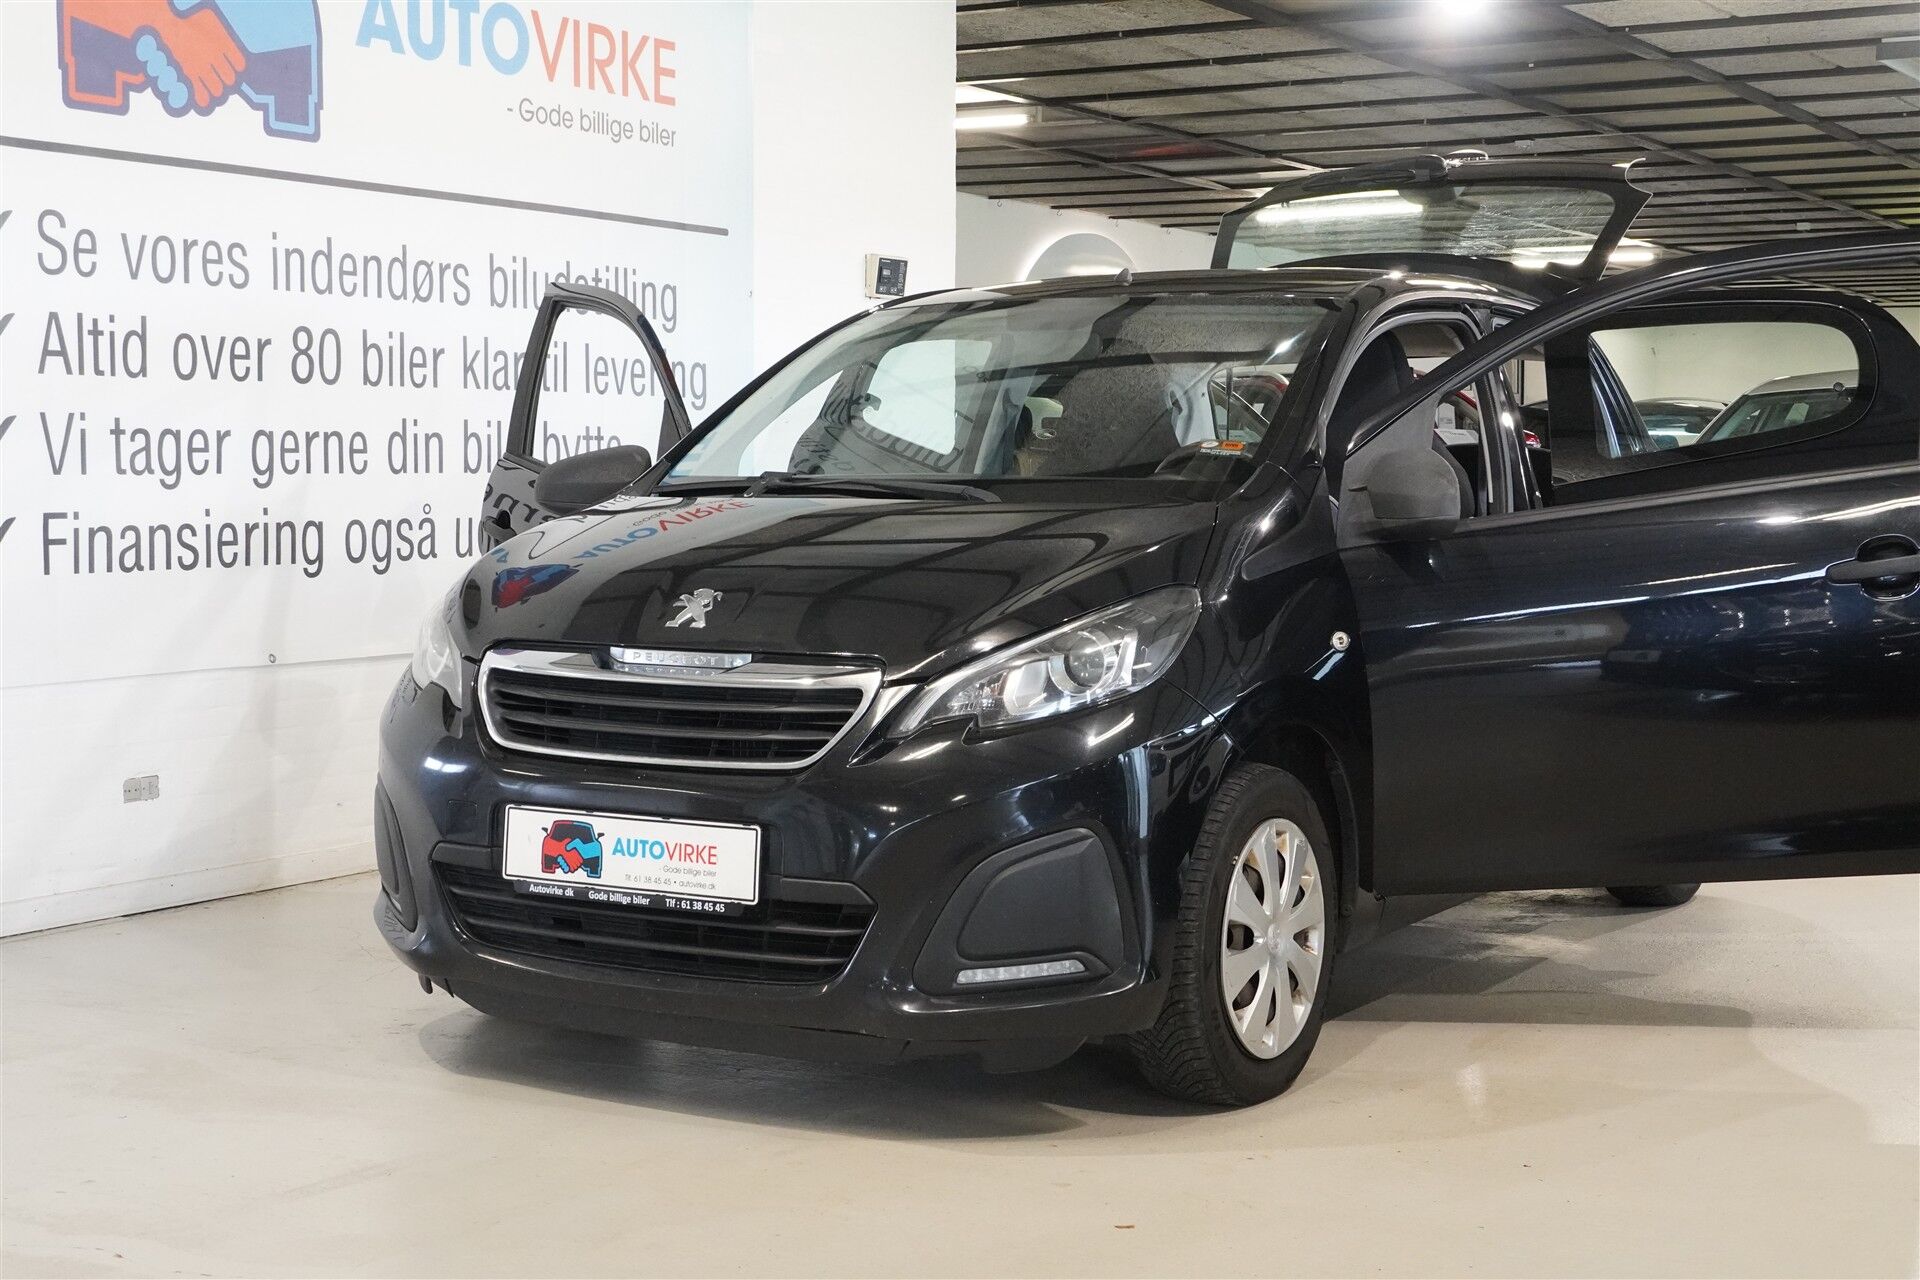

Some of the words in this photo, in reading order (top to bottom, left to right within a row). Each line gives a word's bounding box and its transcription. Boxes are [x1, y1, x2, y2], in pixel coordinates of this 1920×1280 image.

[355, 0, 677, 107] AUTOVIRKE
[519, 97, 574, 129] Gode
[579, 108, 634, 143] billige
[639, 119, 677, 148] biler
[37, 209, 98, 276] Se
[120, 232, 250, 290] vores
[271, 231, 471, 306] indendørs
[37, 311, 148, 379] Altid
[173, 332, 272, 382] over
[290, 325, 342, 385] 80
[362, 328, 446, 389] biler
[462, 335, 526, 391] klar
[585, 343, 707, 411] leverng
[39, 411, 87, 475] Vi
[109, 417, 232, 490] tager
[251, 428, 368, 489] gerne
[387, 418, 444, 474] din
[463, 419, 502, 474] bil
[42, 507, 324, 578] Finansiering
[345, 503, 438, 575] også
[611, 837, 718, 865] AUTOVIRKE
[663, 865, 682, 875] Gode
[529, 884, 563, 896] Autovirke
[588, 890, 608, 901] Gode
[609, 893, 632, 905] billige
[632, 896, 651, 906] biler
[663, 878, 672, 886] 45
[681, 900, 691, 909] 61
[692, 902, 703, 911] 38
[703, 903, 714, 912] 45
[714, 904, 726, 913] 45
